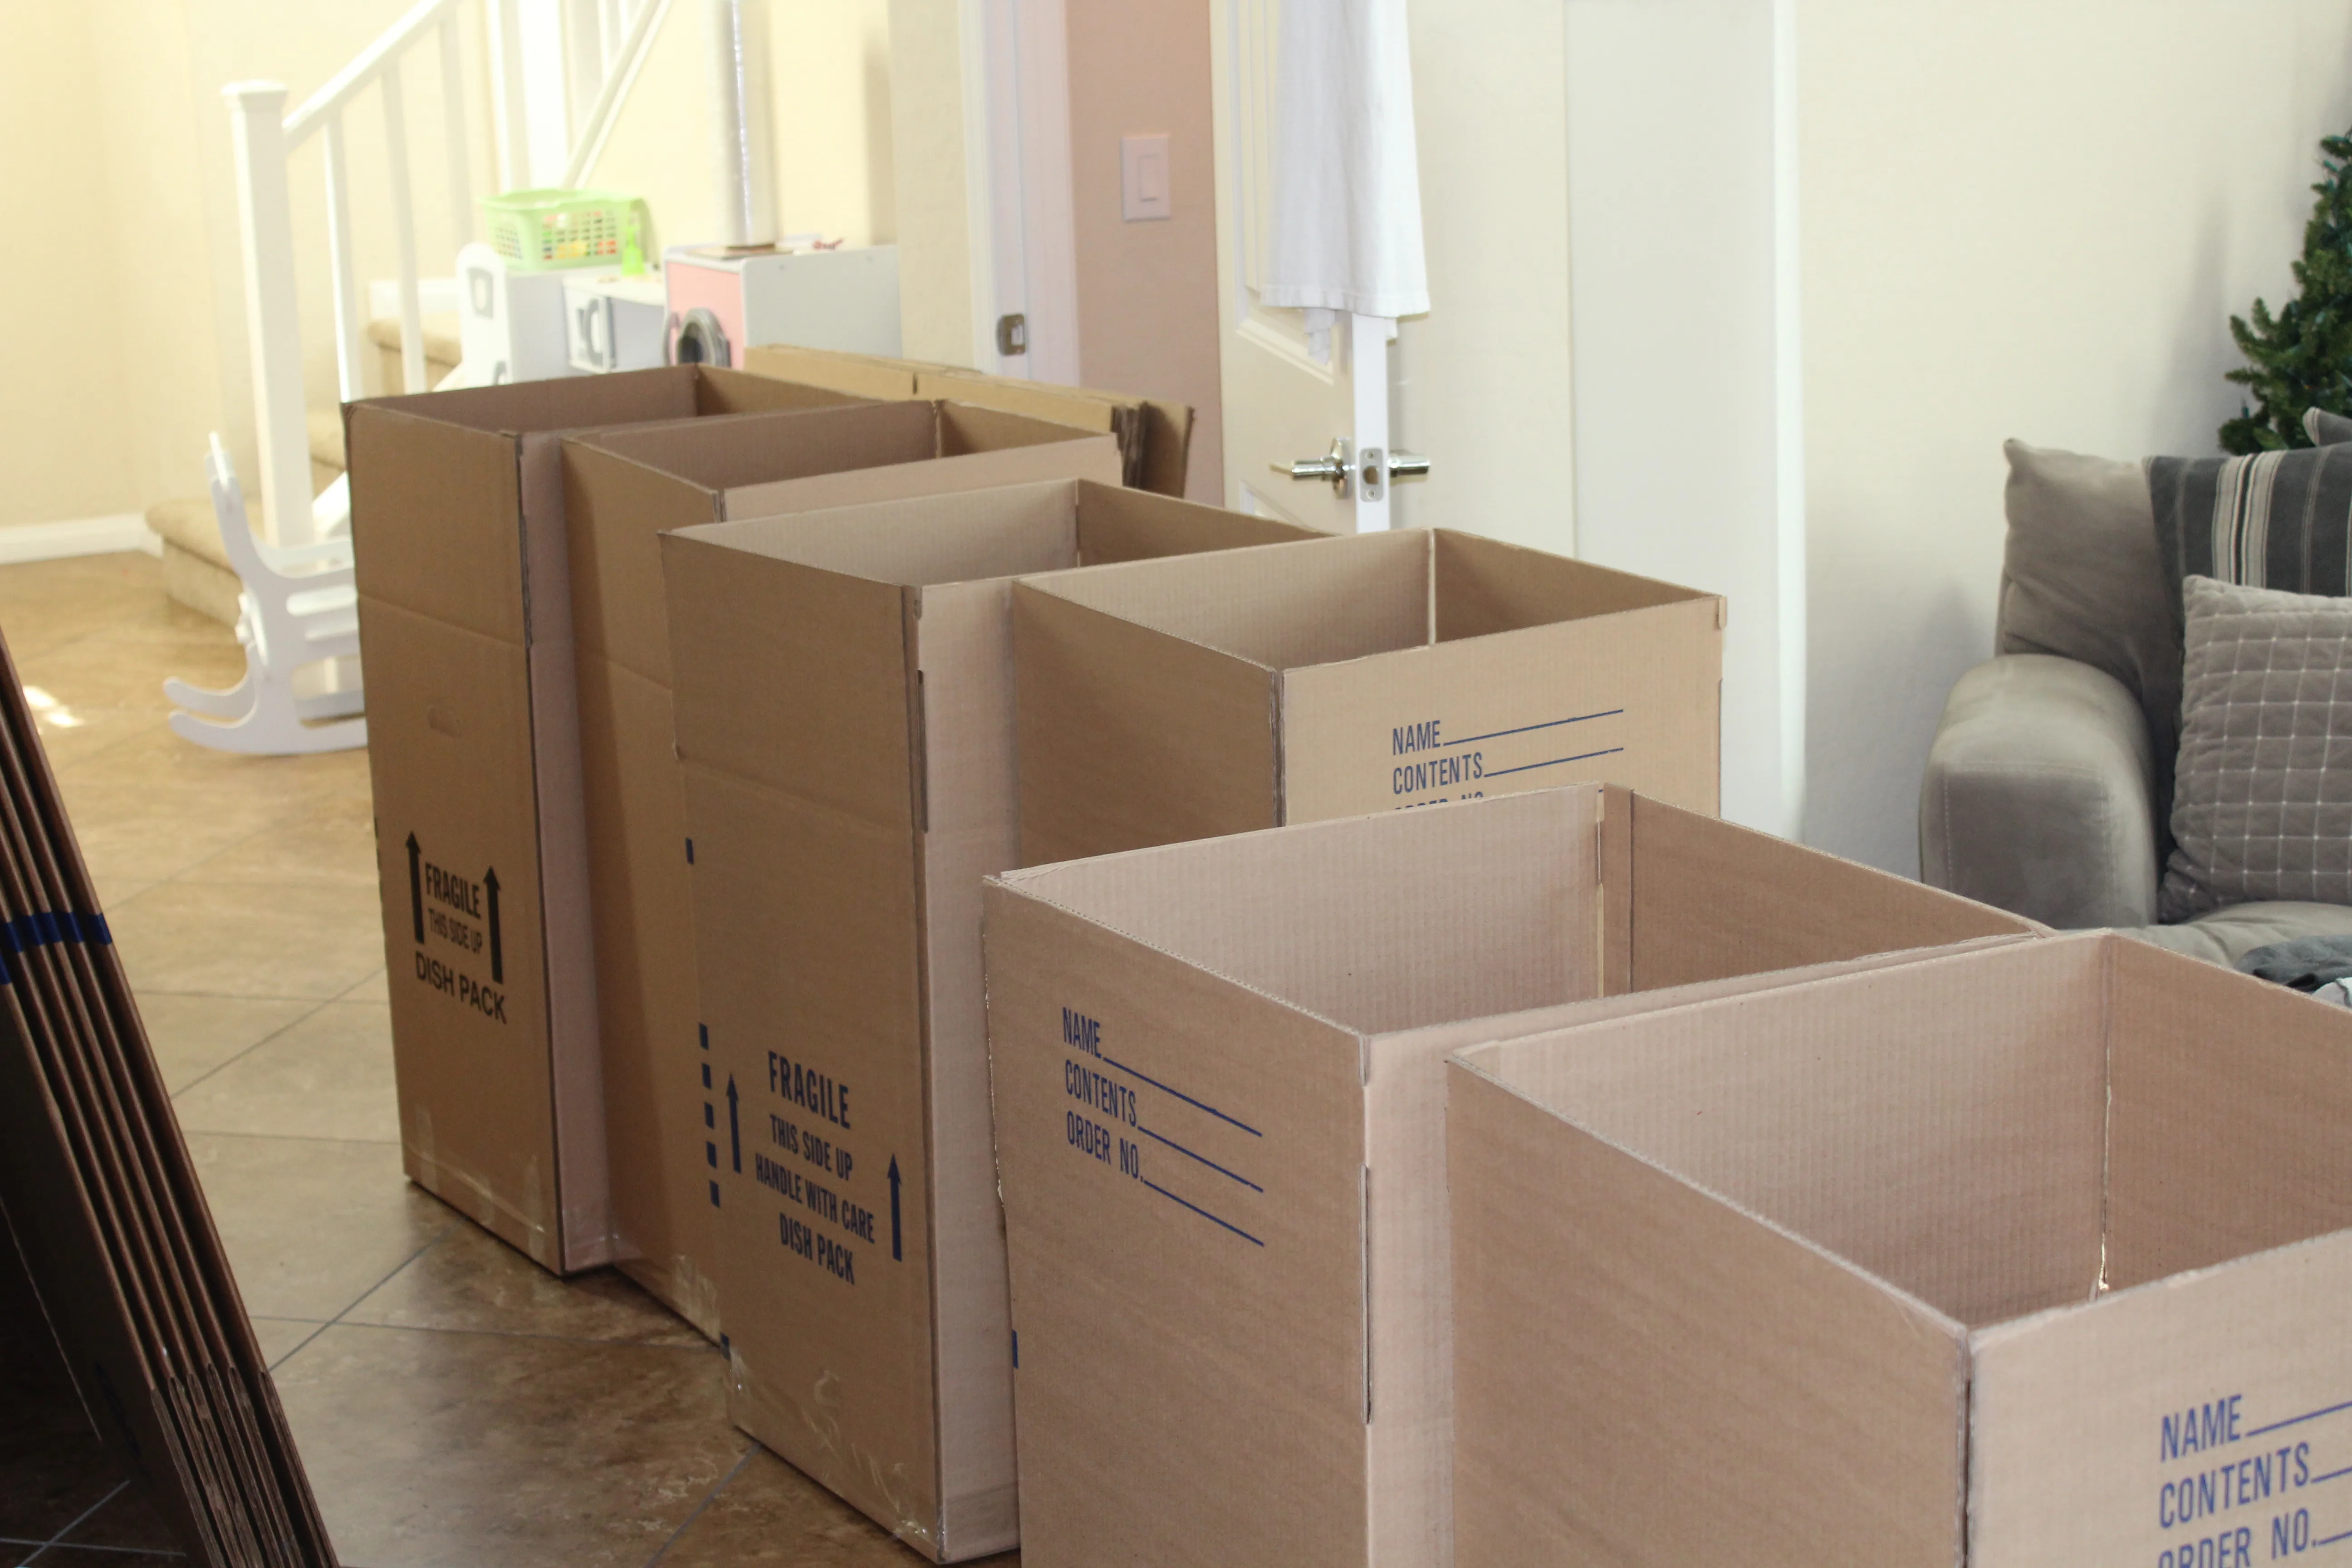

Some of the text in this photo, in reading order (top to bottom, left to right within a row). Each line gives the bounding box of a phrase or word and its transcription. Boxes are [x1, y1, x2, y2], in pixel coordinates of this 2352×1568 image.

[1393, 720, 1441, 755] NAME
[1393, 752, 1483, 794] CONTENTS
[425, 862, 481, 920] FRAGILE
[428, 907, 482, 954] THIS SIDE UP
[416, 951, 506, 1024] DISH PACK
[1063, 1007, 1101, 1058] NAME
[768, 1050, 850, 1129] FRAGILE
[1065, 1059, 1137, 1127] CONTENTS
[770, 1113, 853, 1181] THIS SIDE UP
[1067, 1110, 1143, 1182] ORDER NO.
[755, 1153, 875, 1244] HANDLE WITH CARE
[779, 1213, 855, 1286] DISH PACK
[2161, 1393, 2241, 1463] NAME
[2160, 1441, 2309, 1529] CONTENTS
[2271, 1508, 2317, 1560] NO.
